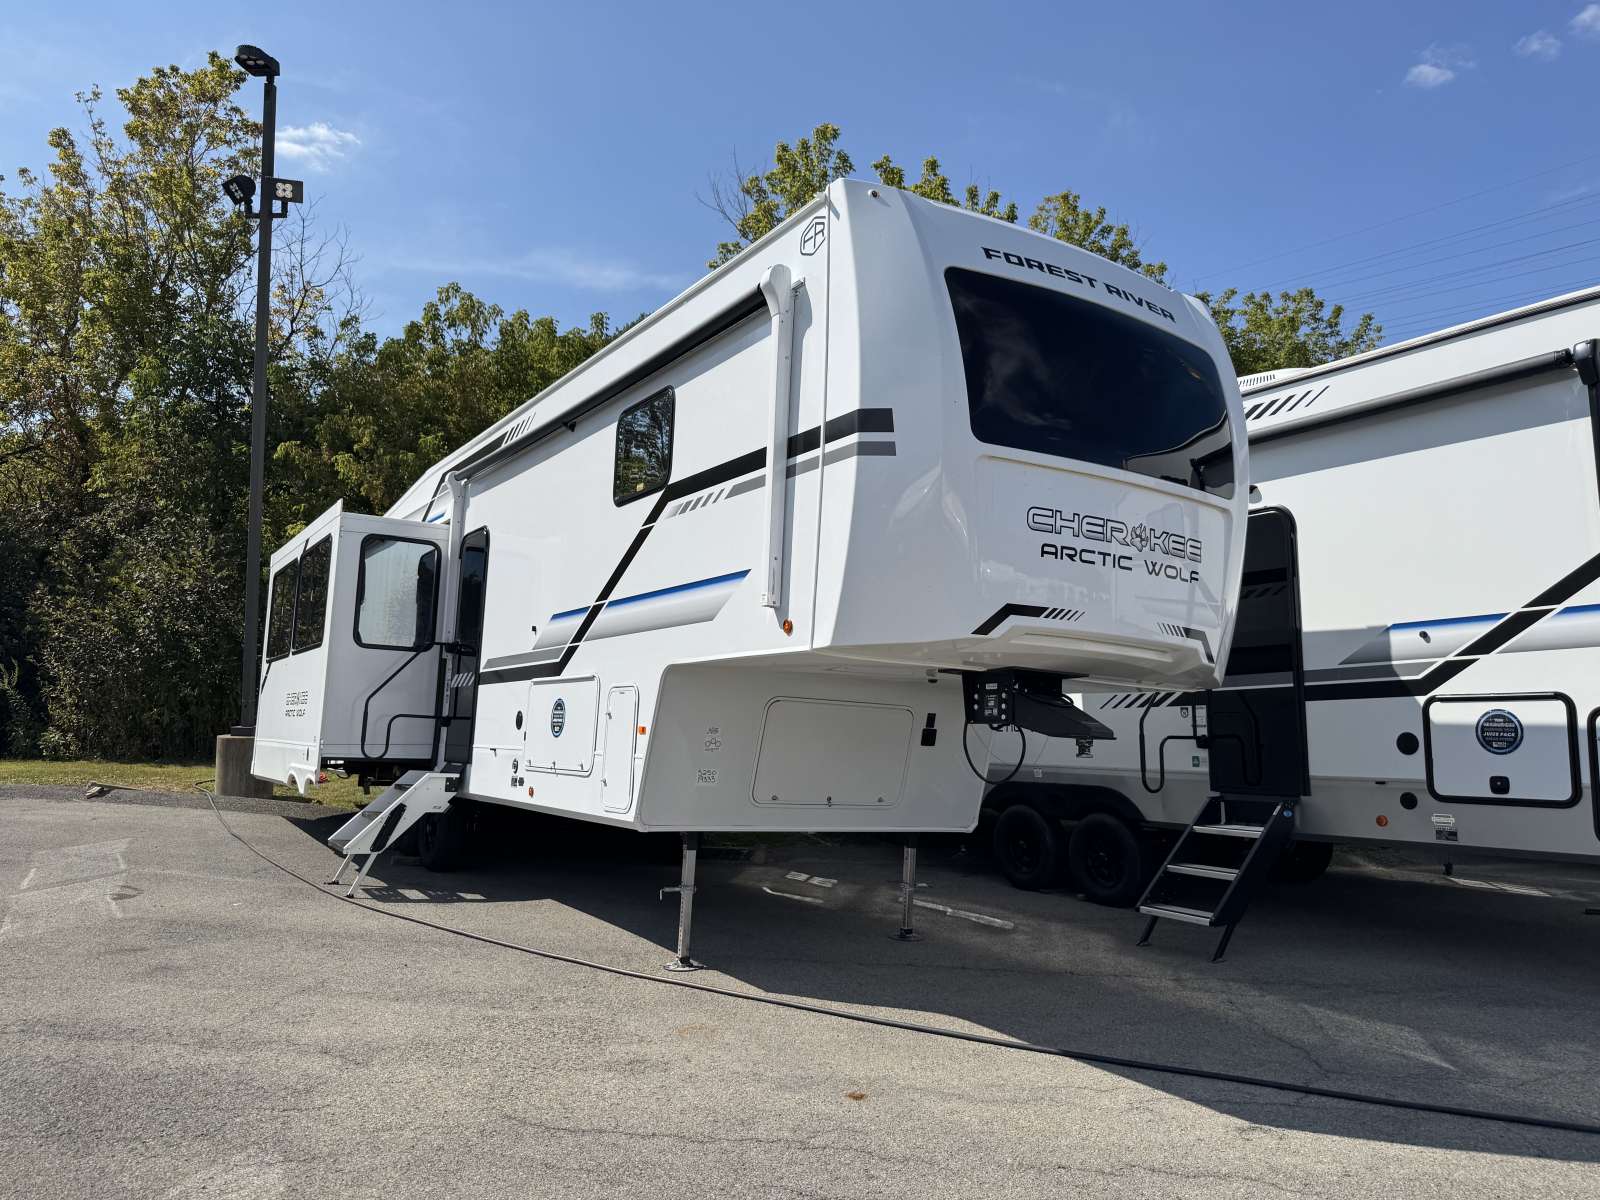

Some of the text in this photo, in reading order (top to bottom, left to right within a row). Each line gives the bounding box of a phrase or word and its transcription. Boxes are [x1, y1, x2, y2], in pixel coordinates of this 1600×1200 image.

[981, 246, 1176, 324] FOREST RIVER
[1040, 543, 1200, 584] ARCTIC WOLF
